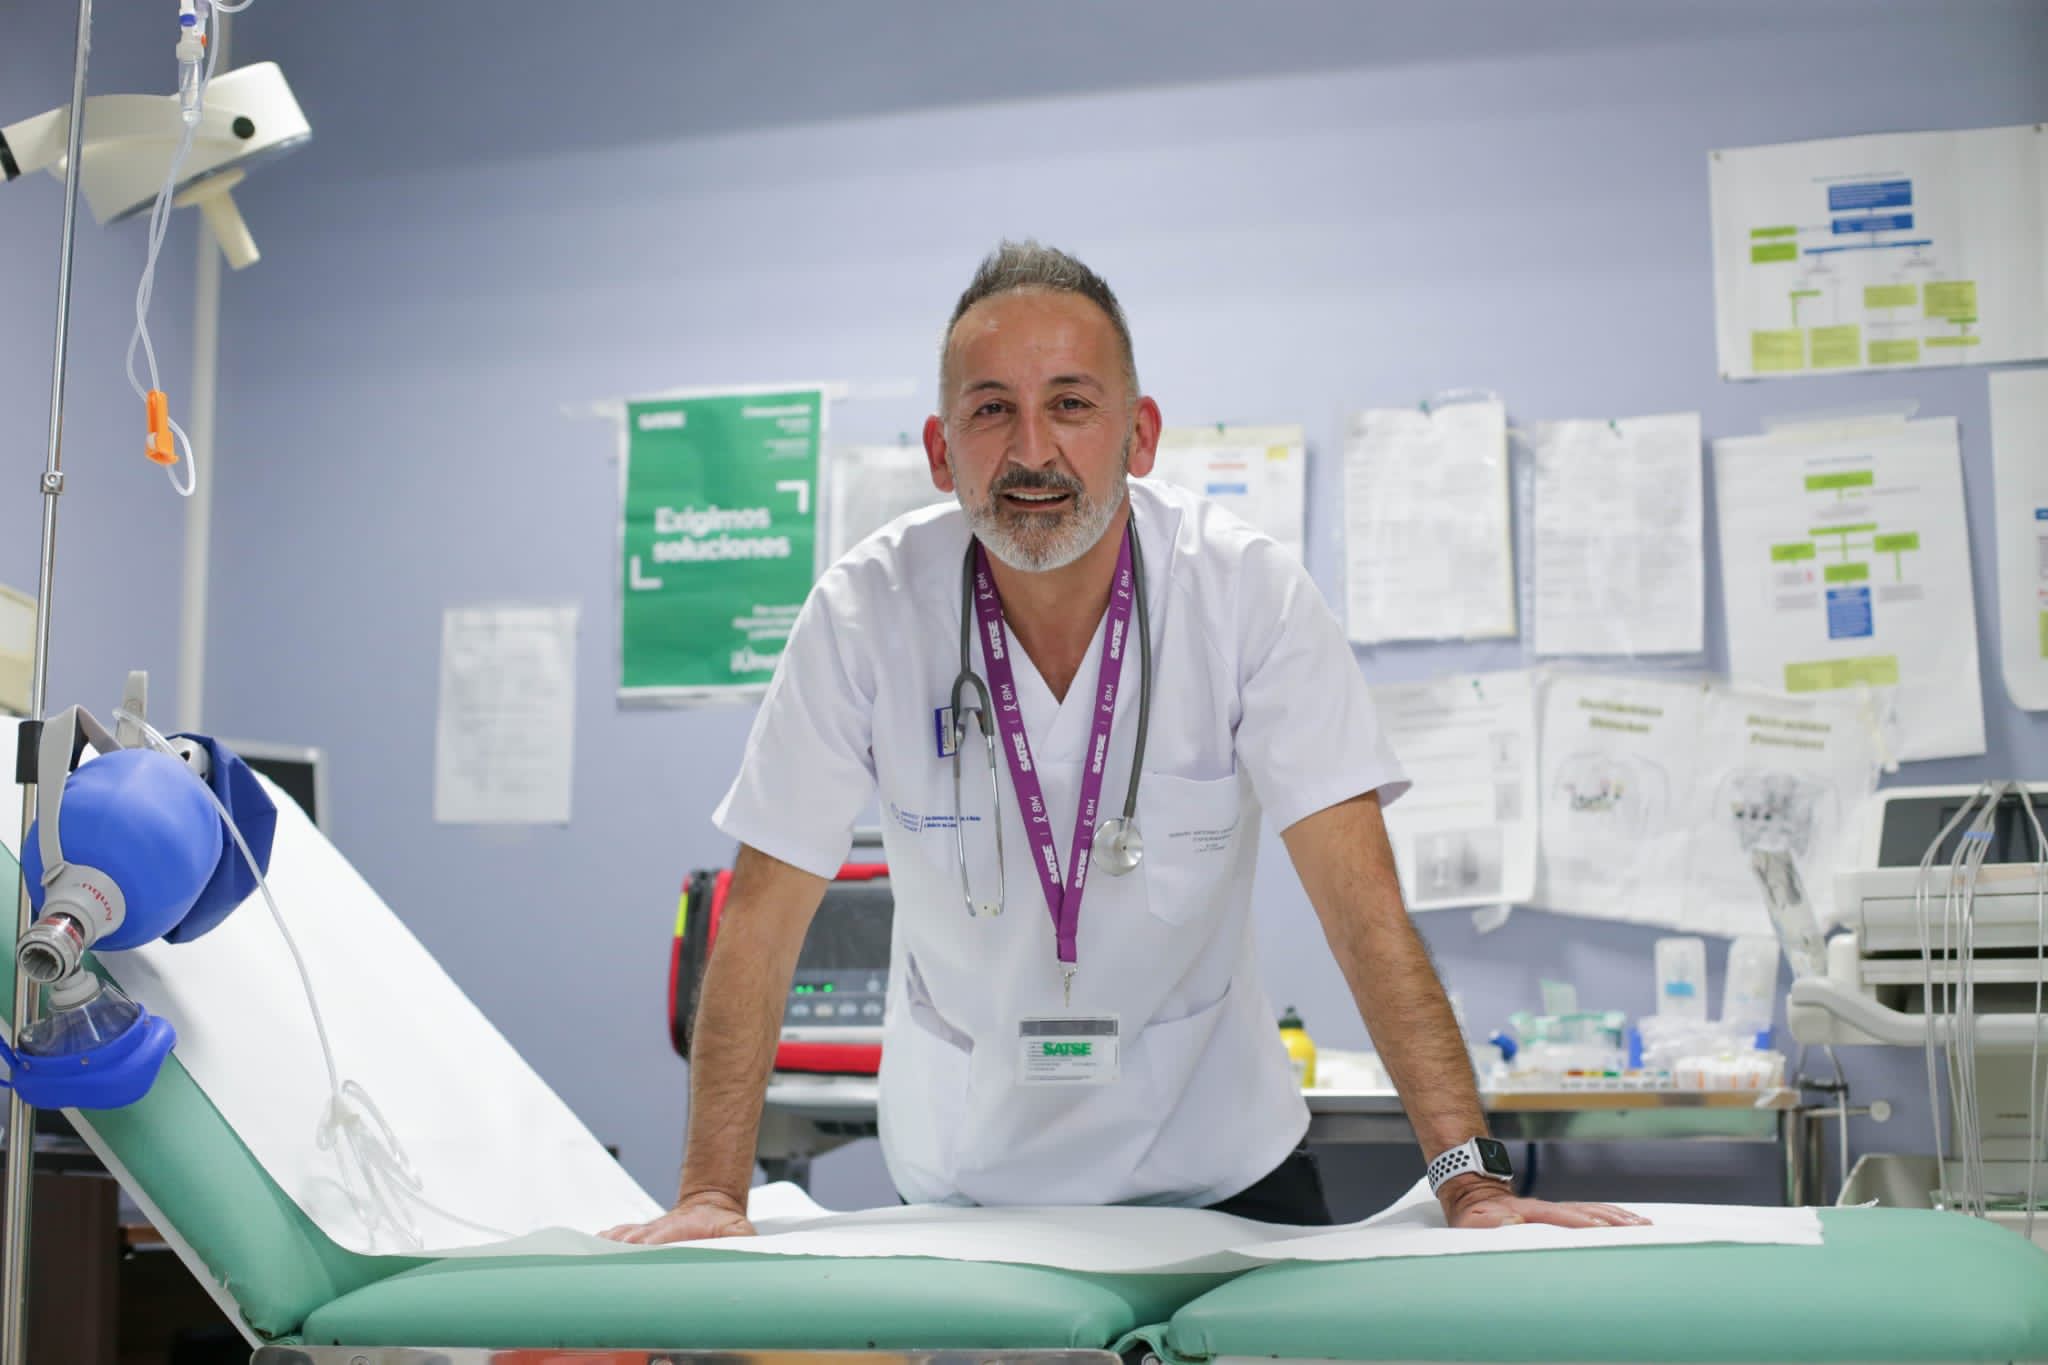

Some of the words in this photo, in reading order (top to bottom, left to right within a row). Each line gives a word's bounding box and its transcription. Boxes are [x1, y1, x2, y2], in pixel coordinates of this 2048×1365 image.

[655, 505, 771, 537] Exigimos
[653, 533, 791, 562] soluciones
[987, 619, 1004, 660] SATSE
[1109, 618, 1124, 660] SATSE
[1012, 731, 1031, 772] SATSE
[1092, 733, 1107, 775] SATSE
[1042, 844, 1060, 884] SATSE
[1075, 848, 1088, 889] SATSE
[1042, 1041, 1093, 1056] SATSE
